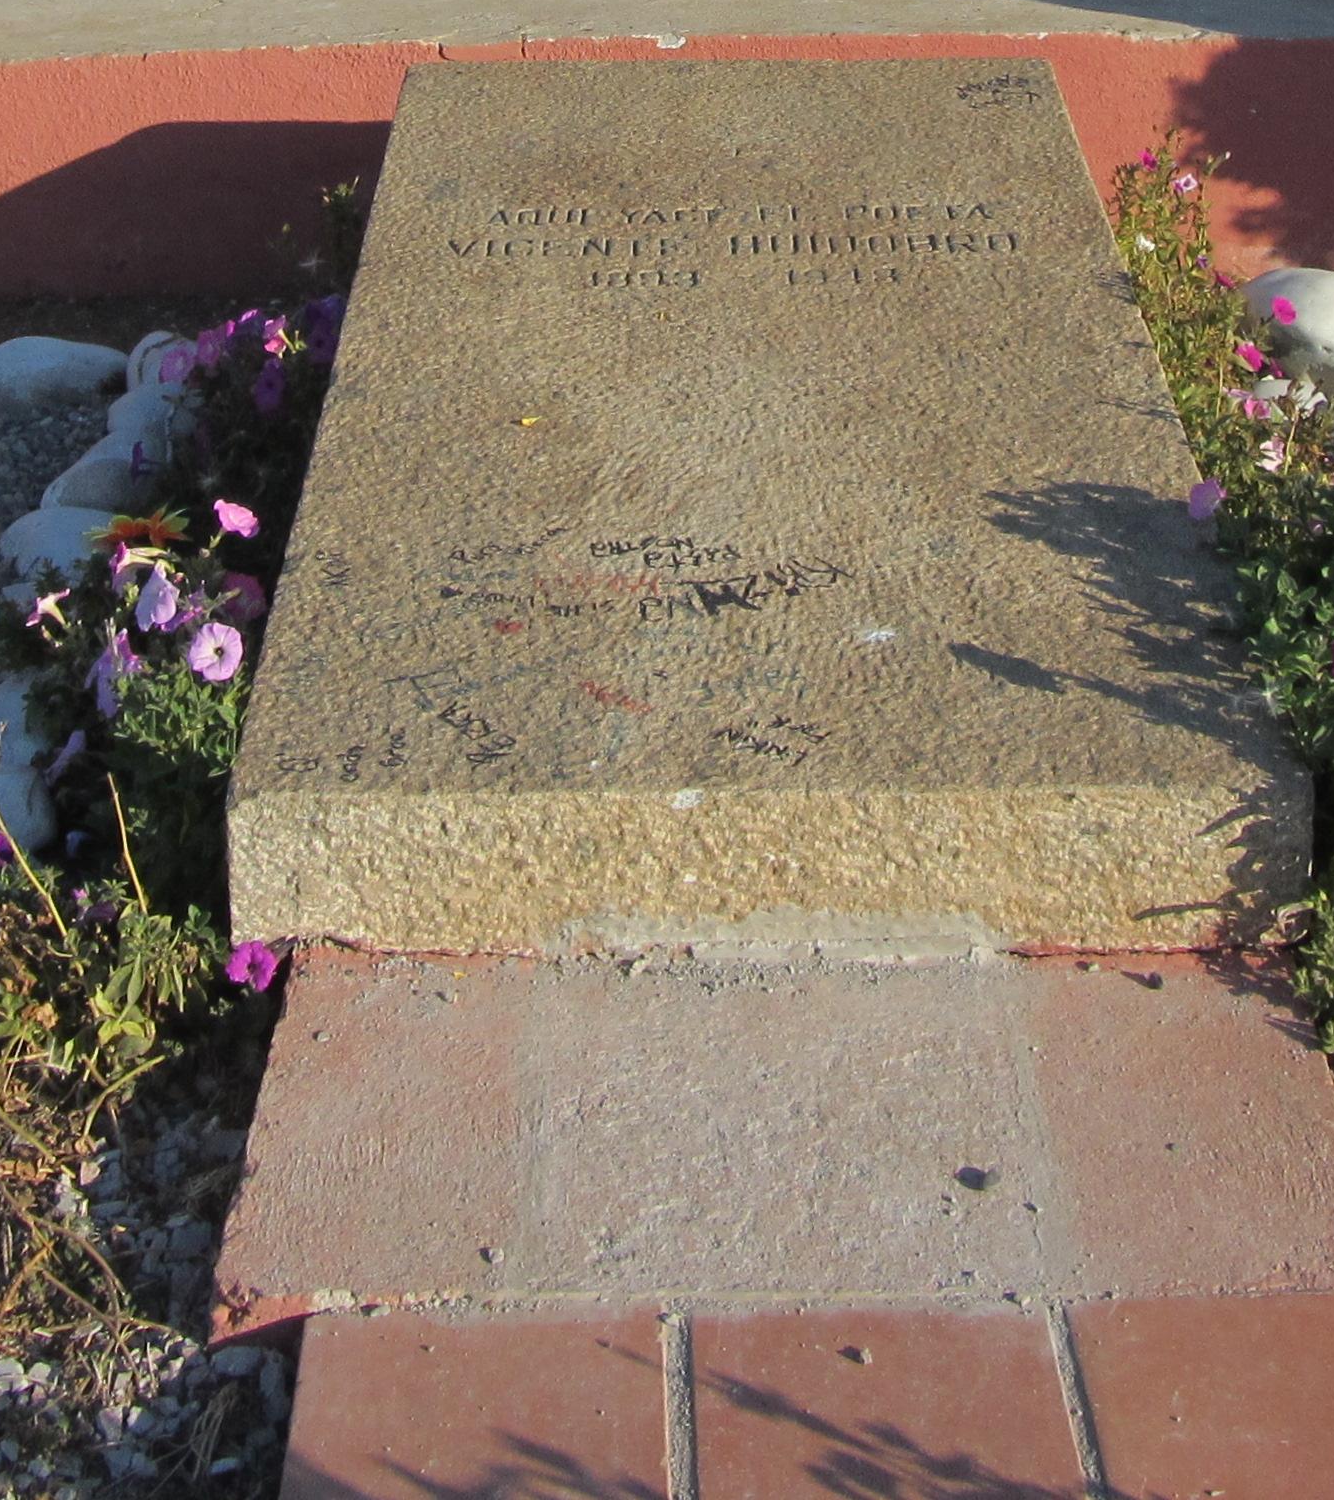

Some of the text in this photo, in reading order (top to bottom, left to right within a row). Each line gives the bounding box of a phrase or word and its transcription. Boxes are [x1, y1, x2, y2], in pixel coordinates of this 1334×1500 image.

[620, 203, 719, 225] YACE
[756, 203, 807, 223] EL
[843, 201, 994, 221] POETA
[447, 233, 1017, 258] VICENTE HUIDOBRO
